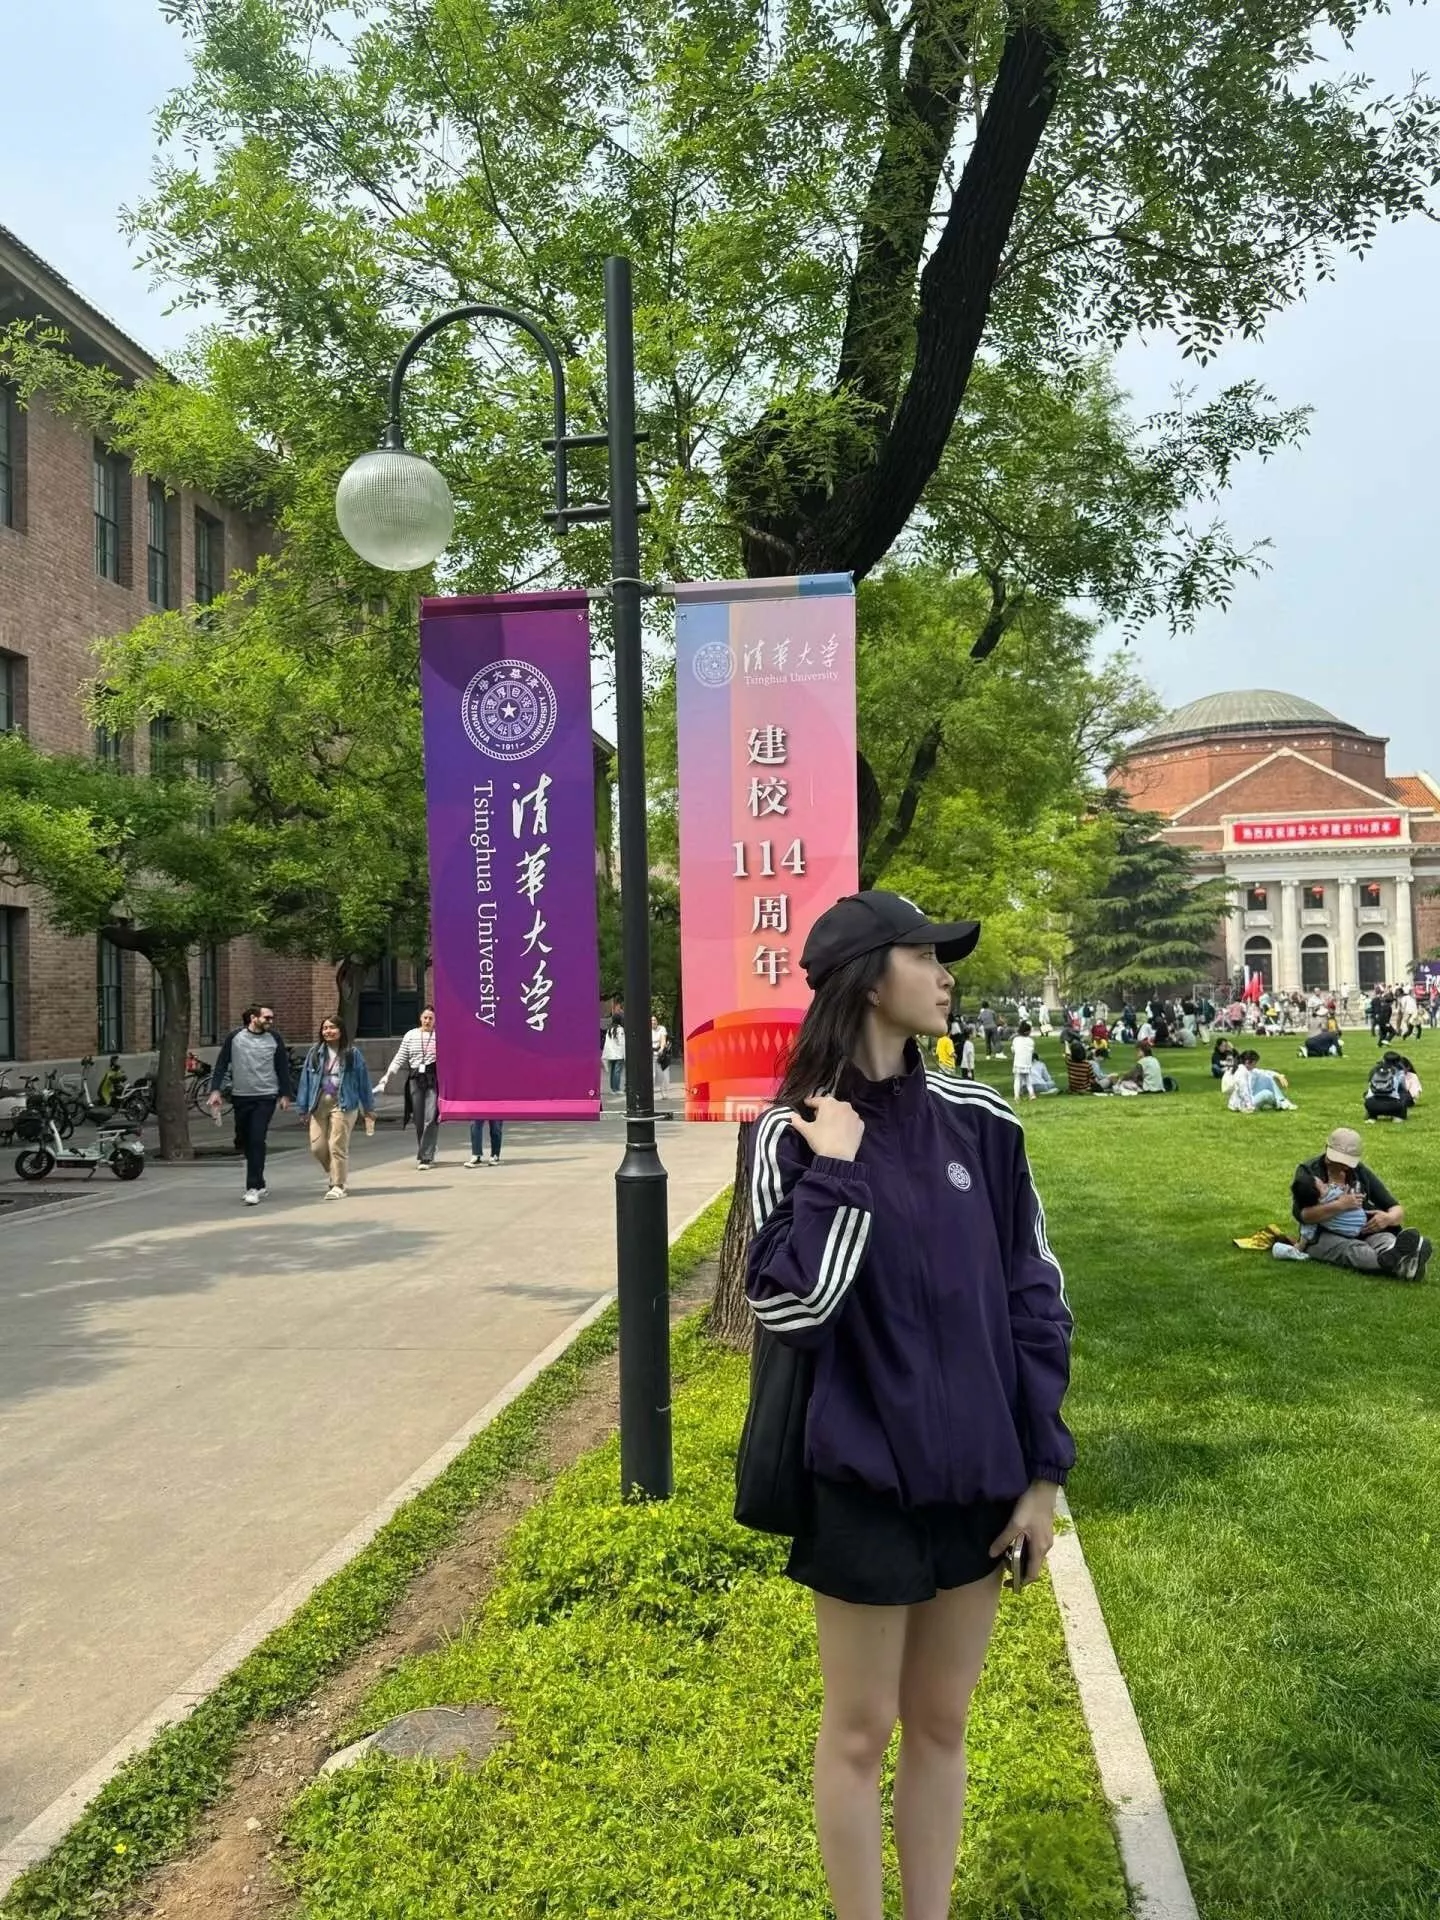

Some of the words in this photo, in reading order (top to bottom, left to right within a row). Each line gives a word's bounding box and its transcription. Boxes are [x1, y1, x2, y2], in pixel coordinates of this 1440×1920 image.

[744, 675, 788, 686] Tsinghua
[790, 671, 839, 683] University
[471, 700, 490, 743] TSINGHUA
[529, 697, 548, 740] UNIVERSITY
[470, 780, 497, 893] Tsinghua
[475, 901, 499, 1027] University
